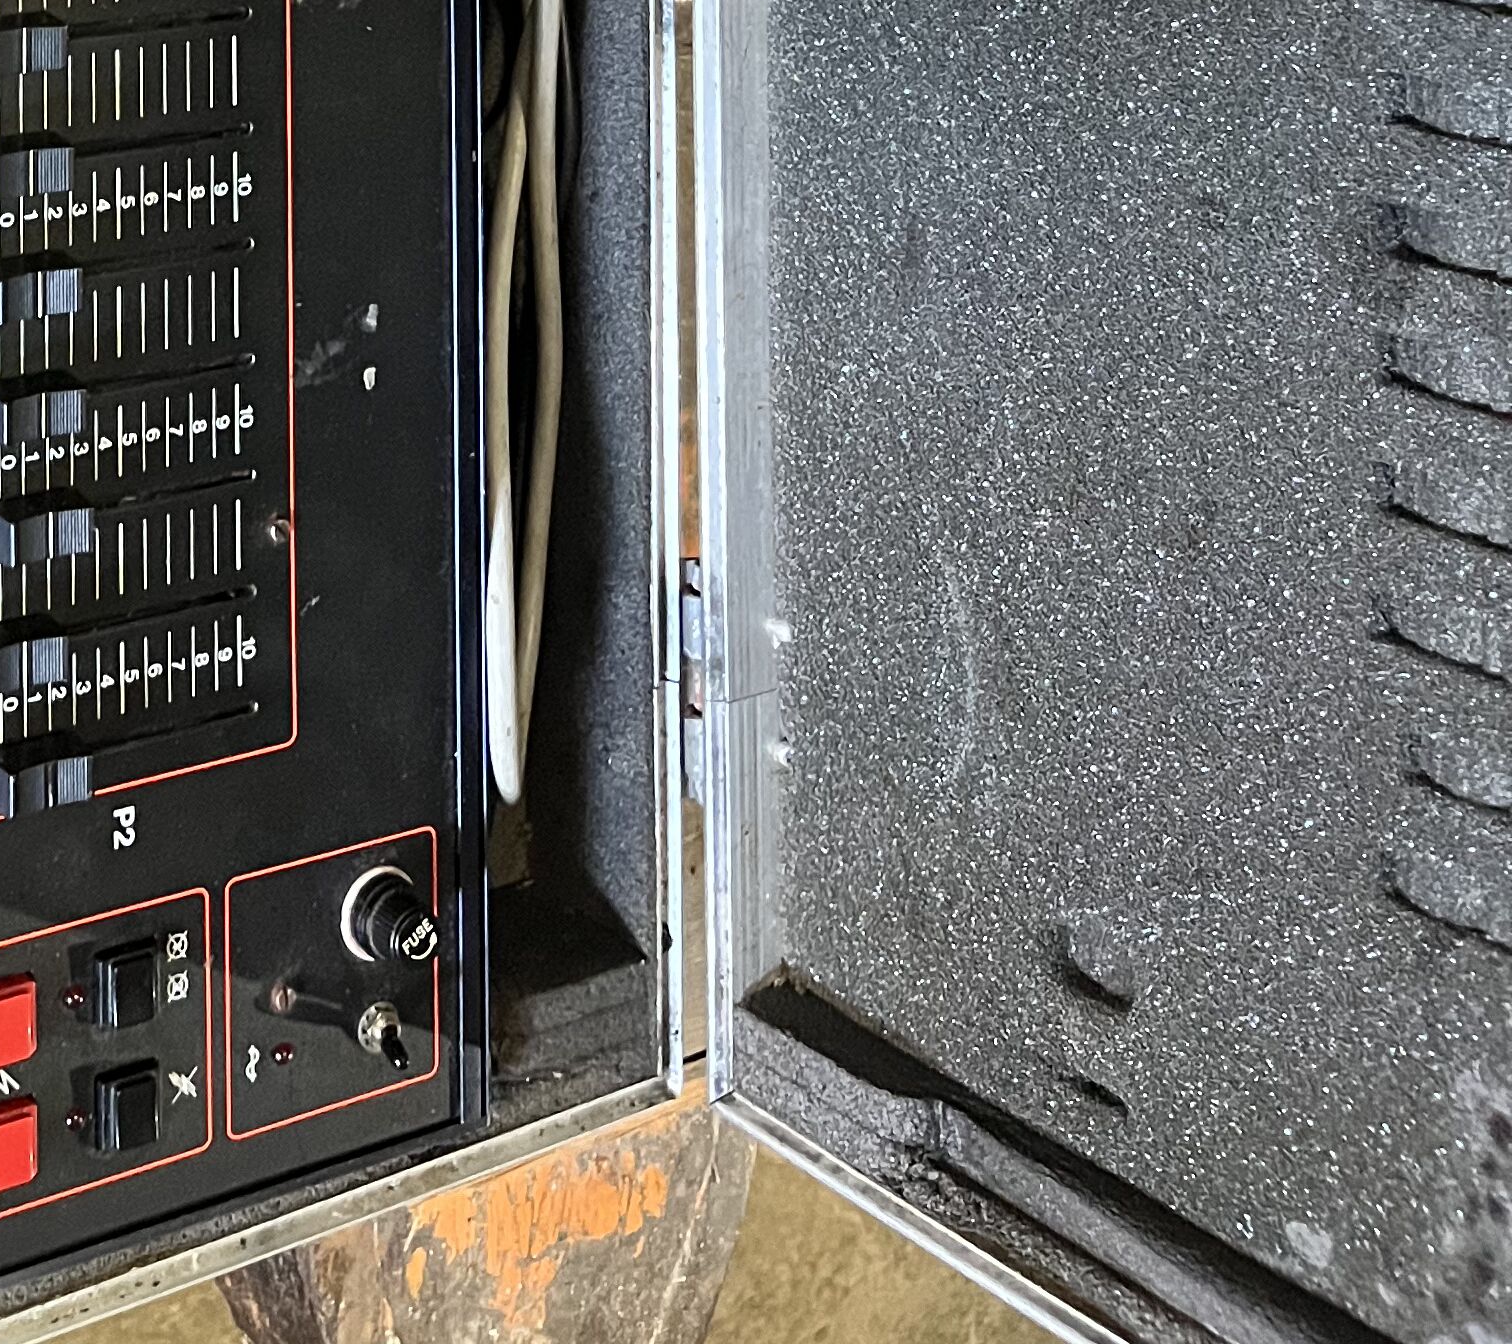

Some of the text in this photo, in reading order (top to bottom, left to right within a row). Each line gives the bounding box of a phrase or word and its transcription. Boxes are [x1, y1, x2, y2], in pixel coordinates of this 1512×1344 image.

[190, 184, 206, 200] 8
[213, 181, 230, 197] 9
[237, 172, 253, 197] 10
[119, 194, 136, 210] 5
[142, 191, 160, 207] 6
[166, 188, 182, 202] 7
[47, 205, 64, 221] 2
[71, 202, 88, 218] 3
[95, 198, 112, 213] 4
[110, 804, 137, 850] P2
[400, 917, 435, 957] FUSE
